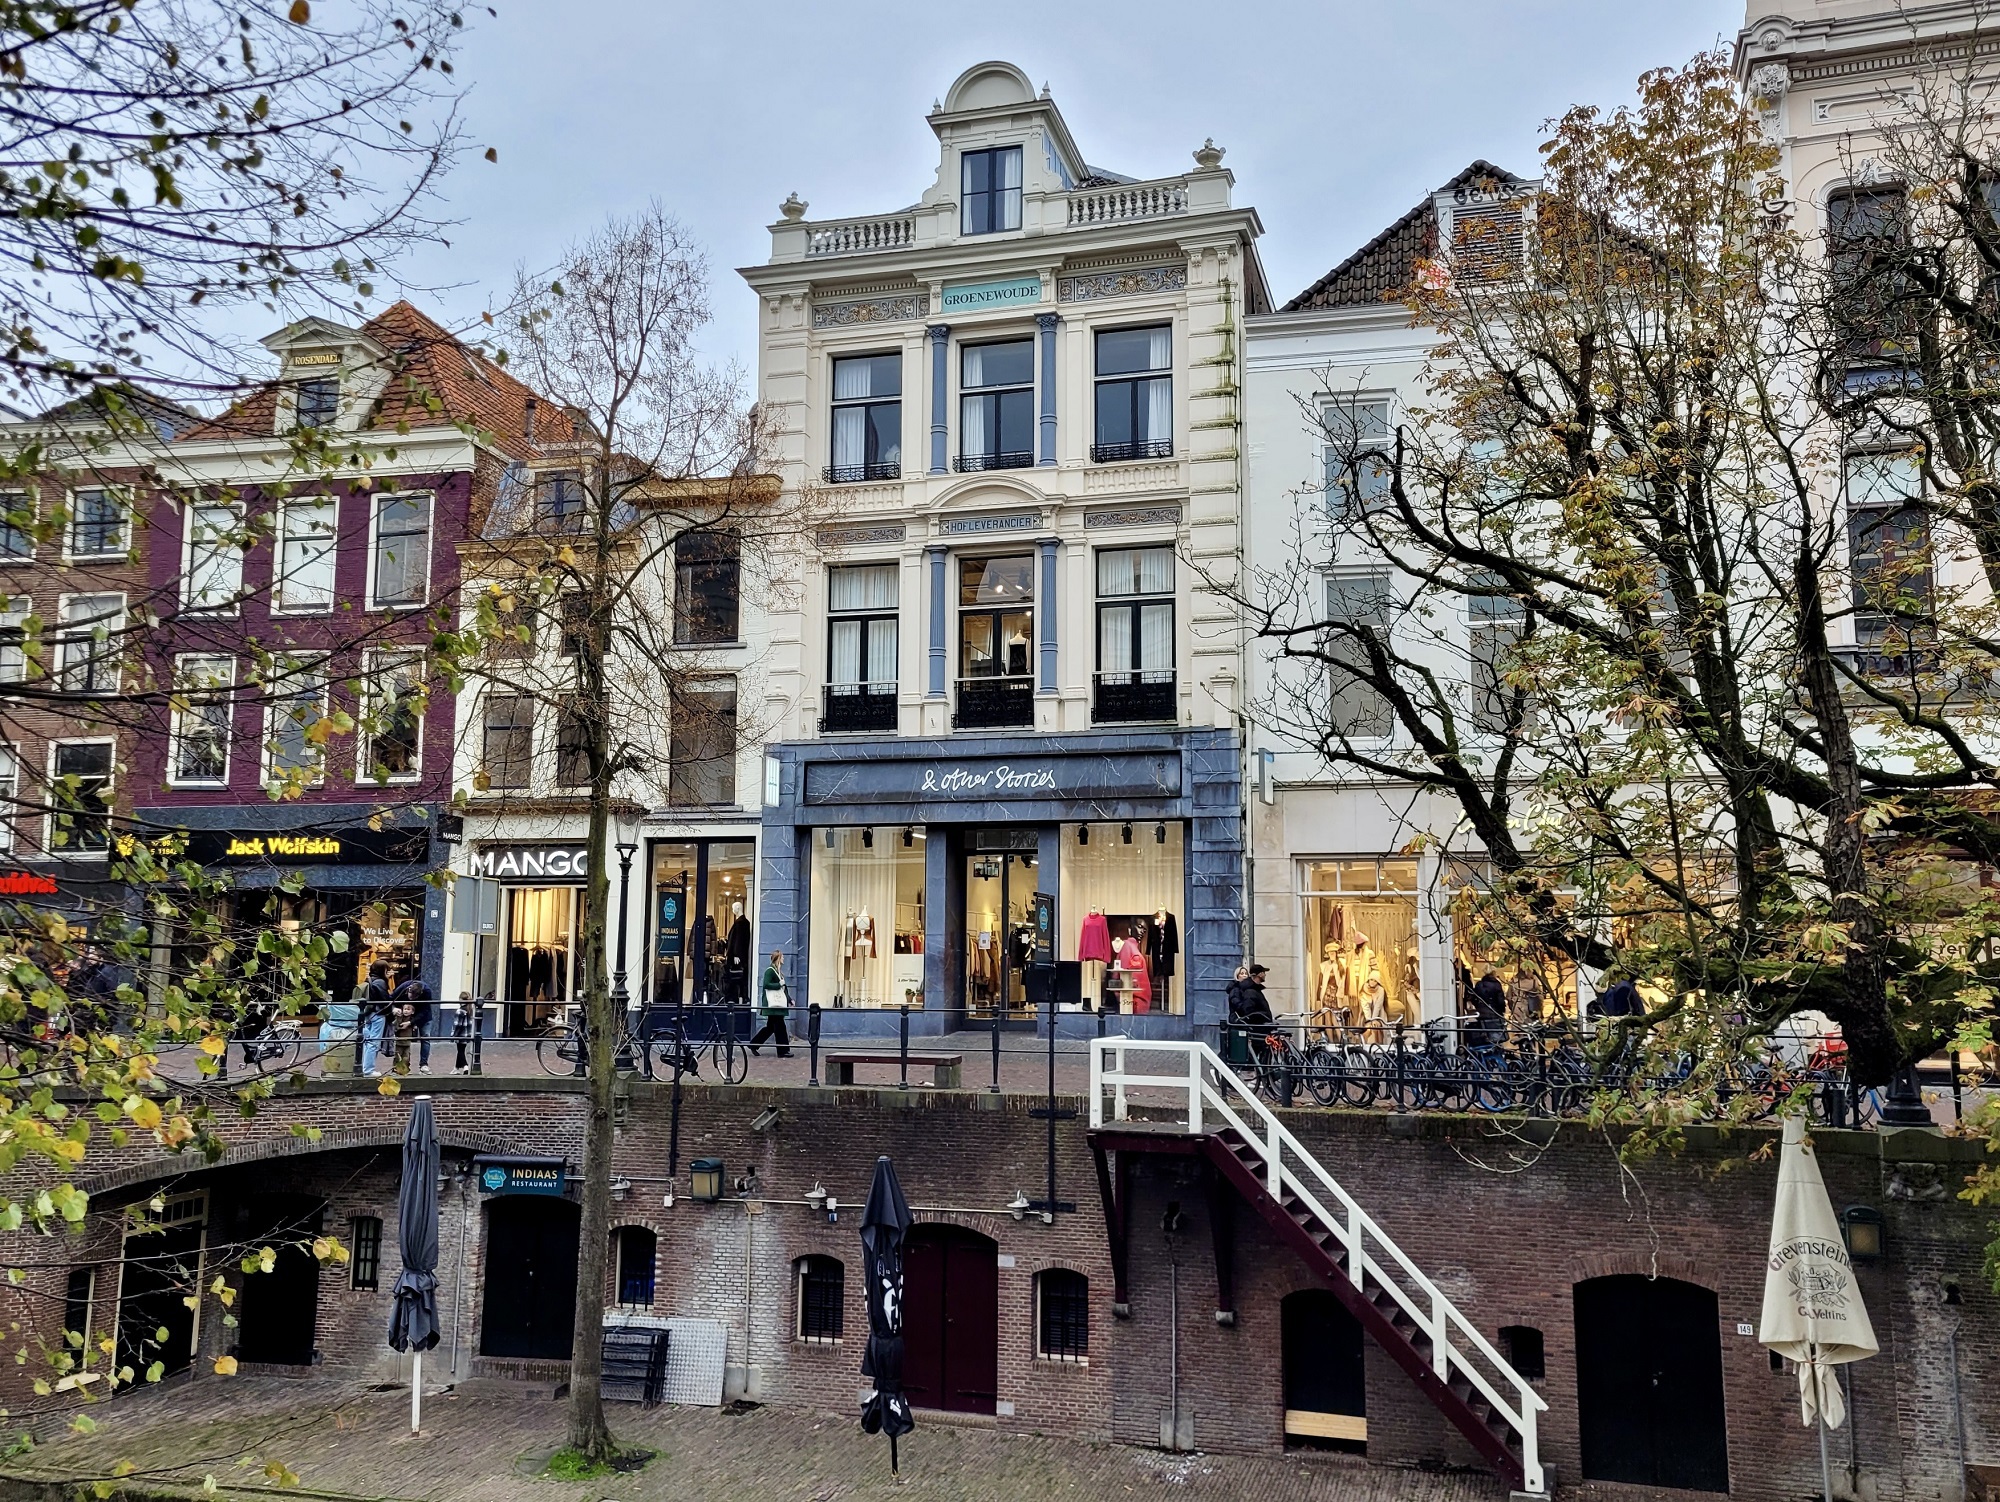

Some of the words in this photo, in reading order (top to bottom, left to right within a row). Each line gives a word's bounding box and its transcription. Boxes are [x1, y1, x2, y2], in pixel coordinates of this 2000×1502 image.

[944, 286, 1039, 306] GROENEWOUDE
[295, 354, 341, 366] ROSENDAEL
[950, 517, 1033, 532] HOFLEVERANCIER
[921, 769, 940, 792] &
[940, 768, 994, 791] other
[994, 765, 1057, 789] Stories
[442, 832, 462, 841] MANGO
[226, 837, 265, 855] Jack
[267, 837, 340, 855] Wolfskin
[363, 927, 376, 936] We
[377, 927, 394, 936] Live
[363, 936, 372, 945] to
[373, 936, 406, 945] Discover
[511, 1168, 559, 1180] INDIAAS
[511, 1180, 558, 1188] RESTAURANT
[1812, 1308, 1847, 1321] Veltins
[1739, 1325, 1751, 1334] 149
